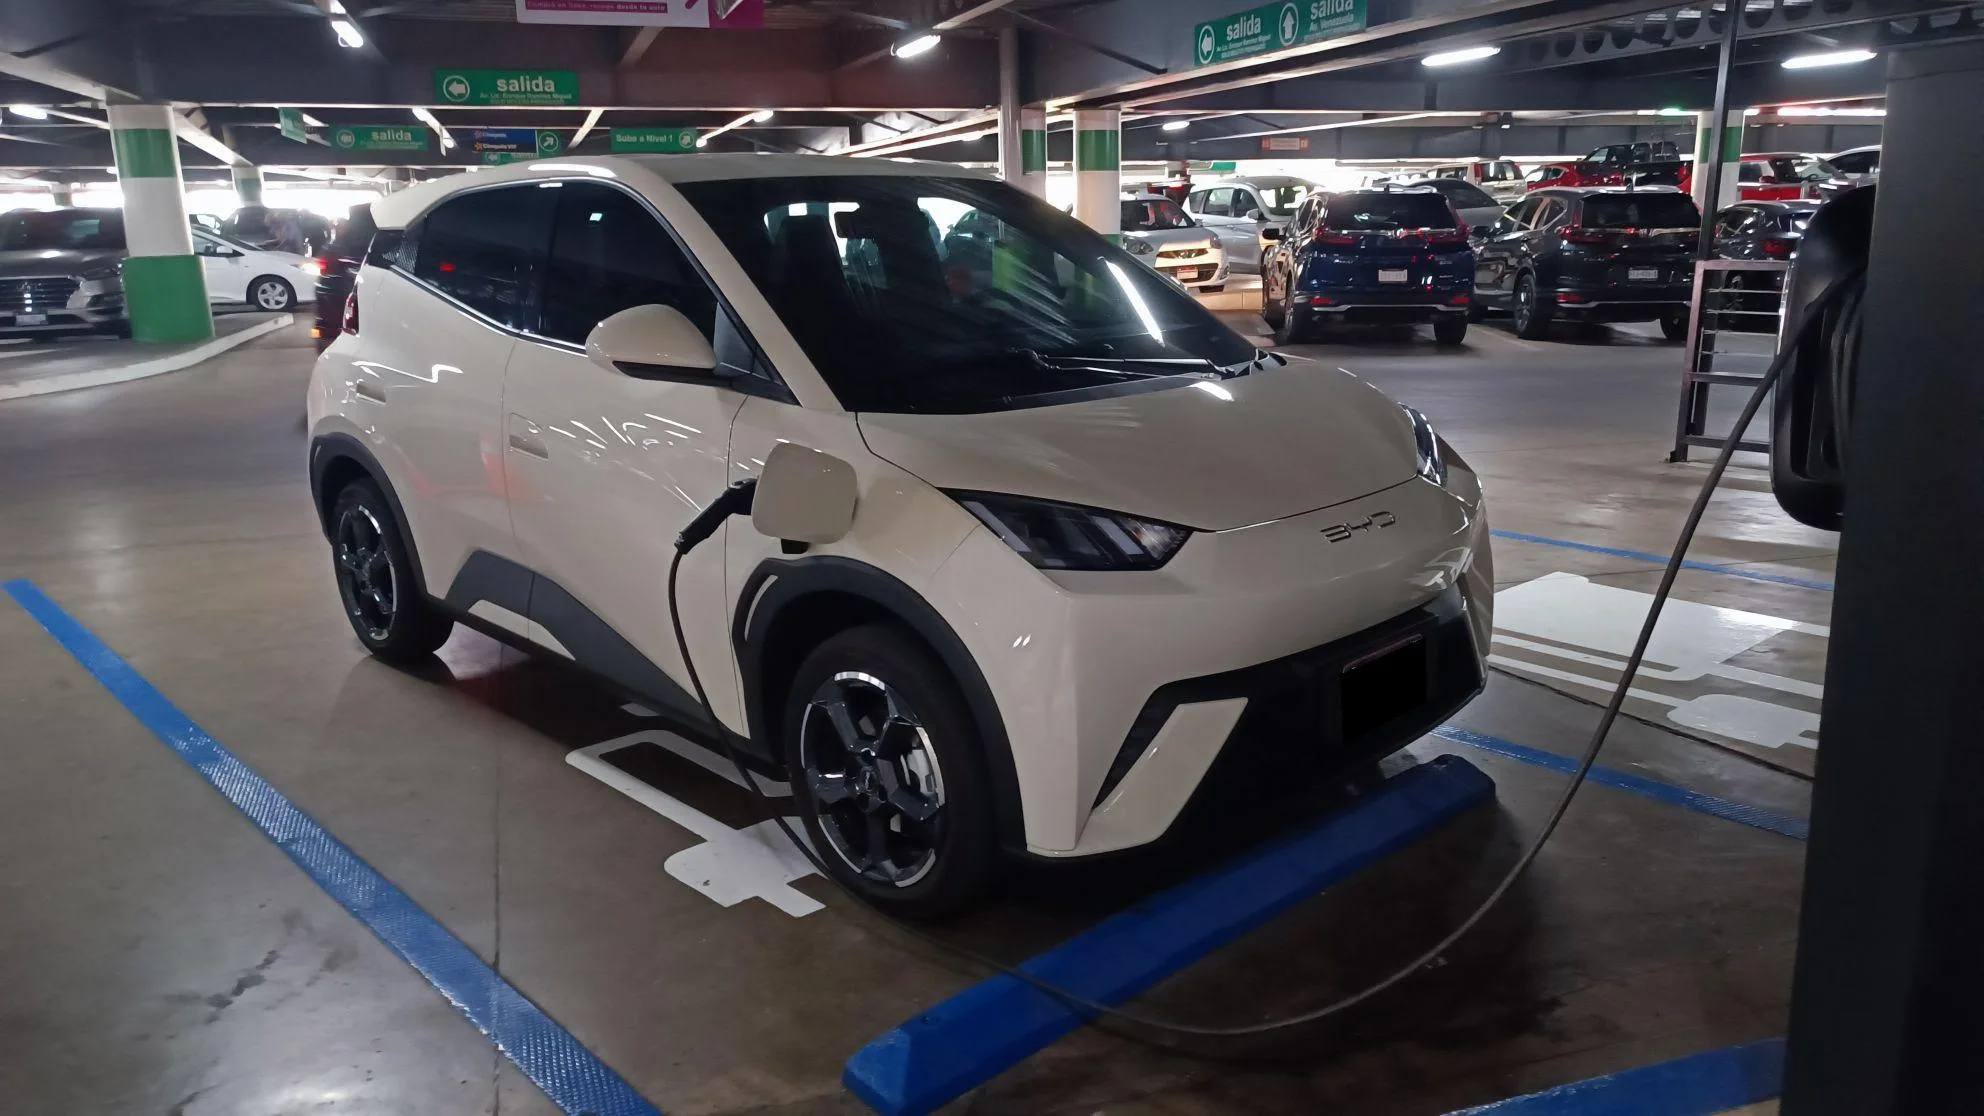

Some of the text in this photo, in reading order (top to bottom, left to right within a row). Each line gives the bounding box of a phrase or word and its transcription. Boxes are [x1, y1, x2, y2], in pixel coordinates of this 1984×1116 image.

[1310, 0, 1354, 20] salida
[1226, 14, 1261, 41] salida
[497, 76, 555, 92] salida
[371, 129, 412, 141] salida
[1320, 510, 1396, 544] BYD
